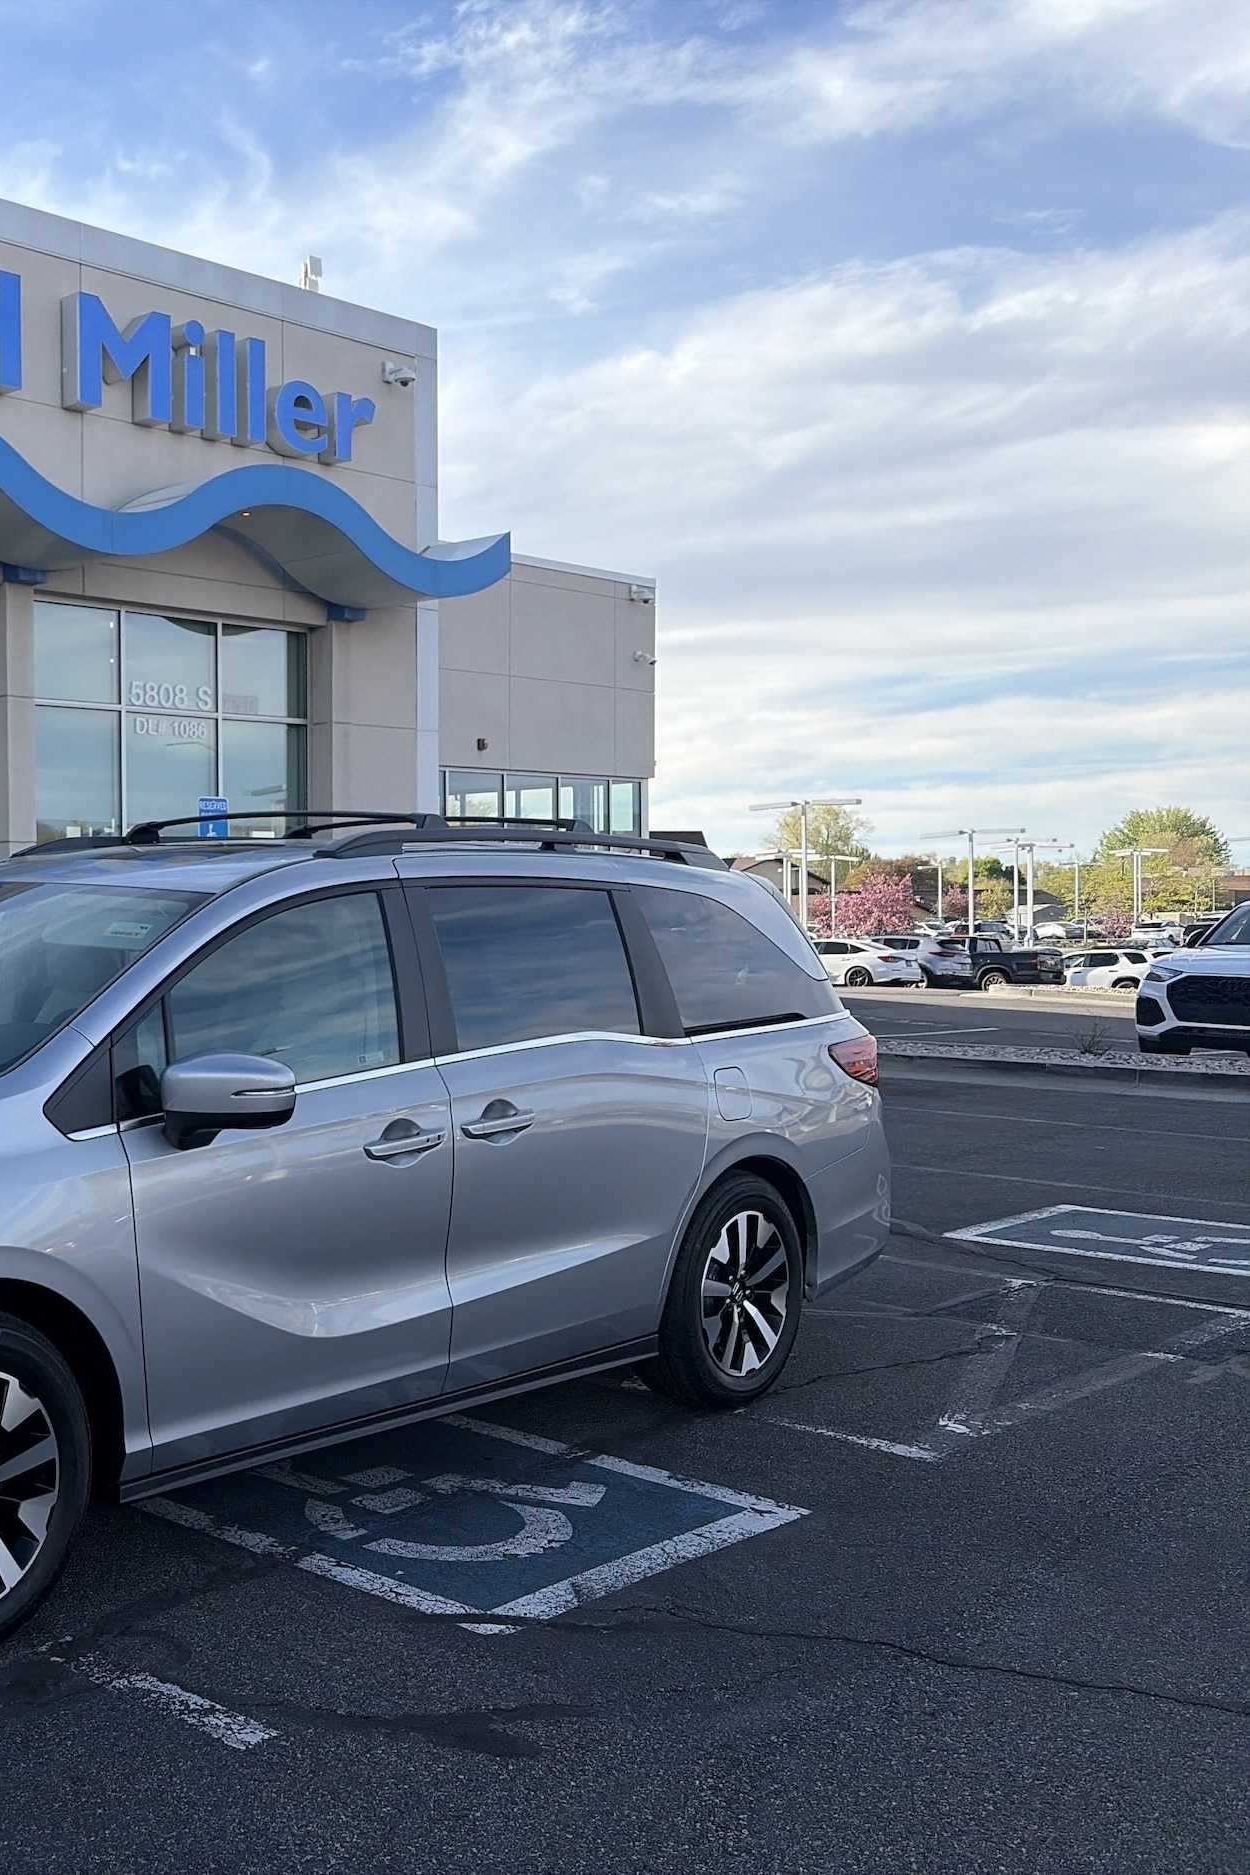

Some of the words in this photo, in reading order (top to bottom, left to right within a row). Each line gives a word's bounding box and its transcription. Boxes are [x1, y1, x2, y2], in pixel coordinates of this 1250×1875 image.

[60, 290, 375, 465] Miller
[129, 681, 189, 709] 5808
[197, 686, 213, 711] S
[134, 716, 166, 736] DL#
[171, 720, 207, 739] 1086
[199, 800, 227, 811] RESERVED
